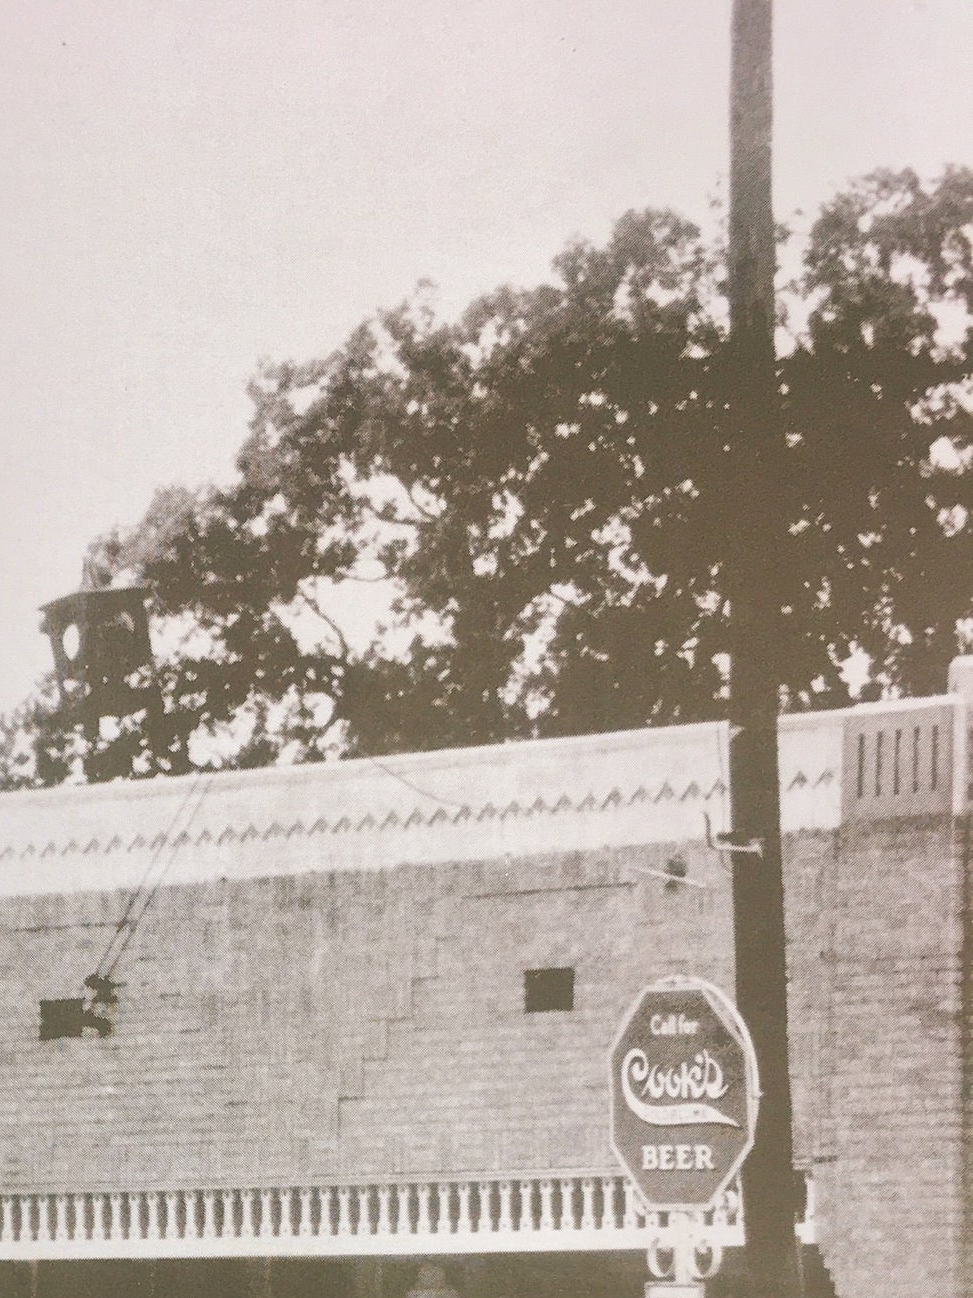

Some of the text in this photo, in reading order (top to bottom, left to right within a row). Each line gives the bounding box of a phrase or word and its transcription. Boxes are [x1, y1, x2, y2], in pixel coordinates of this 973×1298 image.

[650, 1014, 699, 1035] Call for
[642, 1144, 715, 1170] BEER
